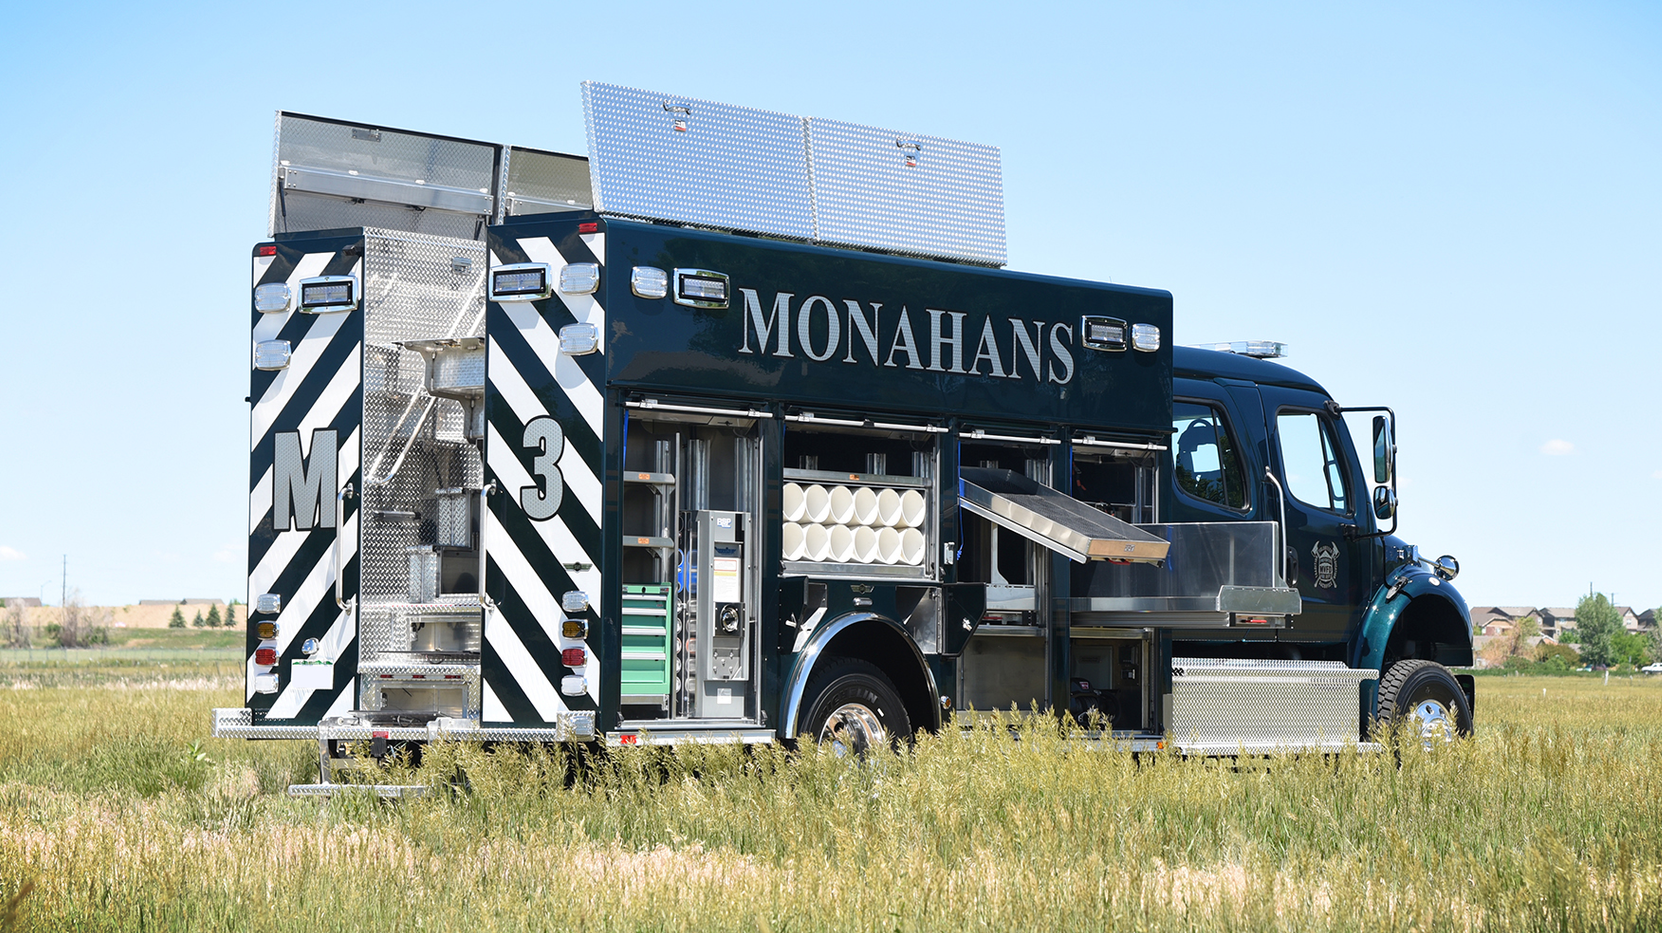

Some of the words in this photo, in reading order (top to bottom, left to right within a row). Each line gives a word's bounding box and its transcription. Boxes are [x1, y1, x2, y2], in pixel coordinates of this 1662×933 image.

[738, 287, 1075, 385] MONAHANS
[273, 429, 338, 530] M
[520, 415, 565, 521] 3
